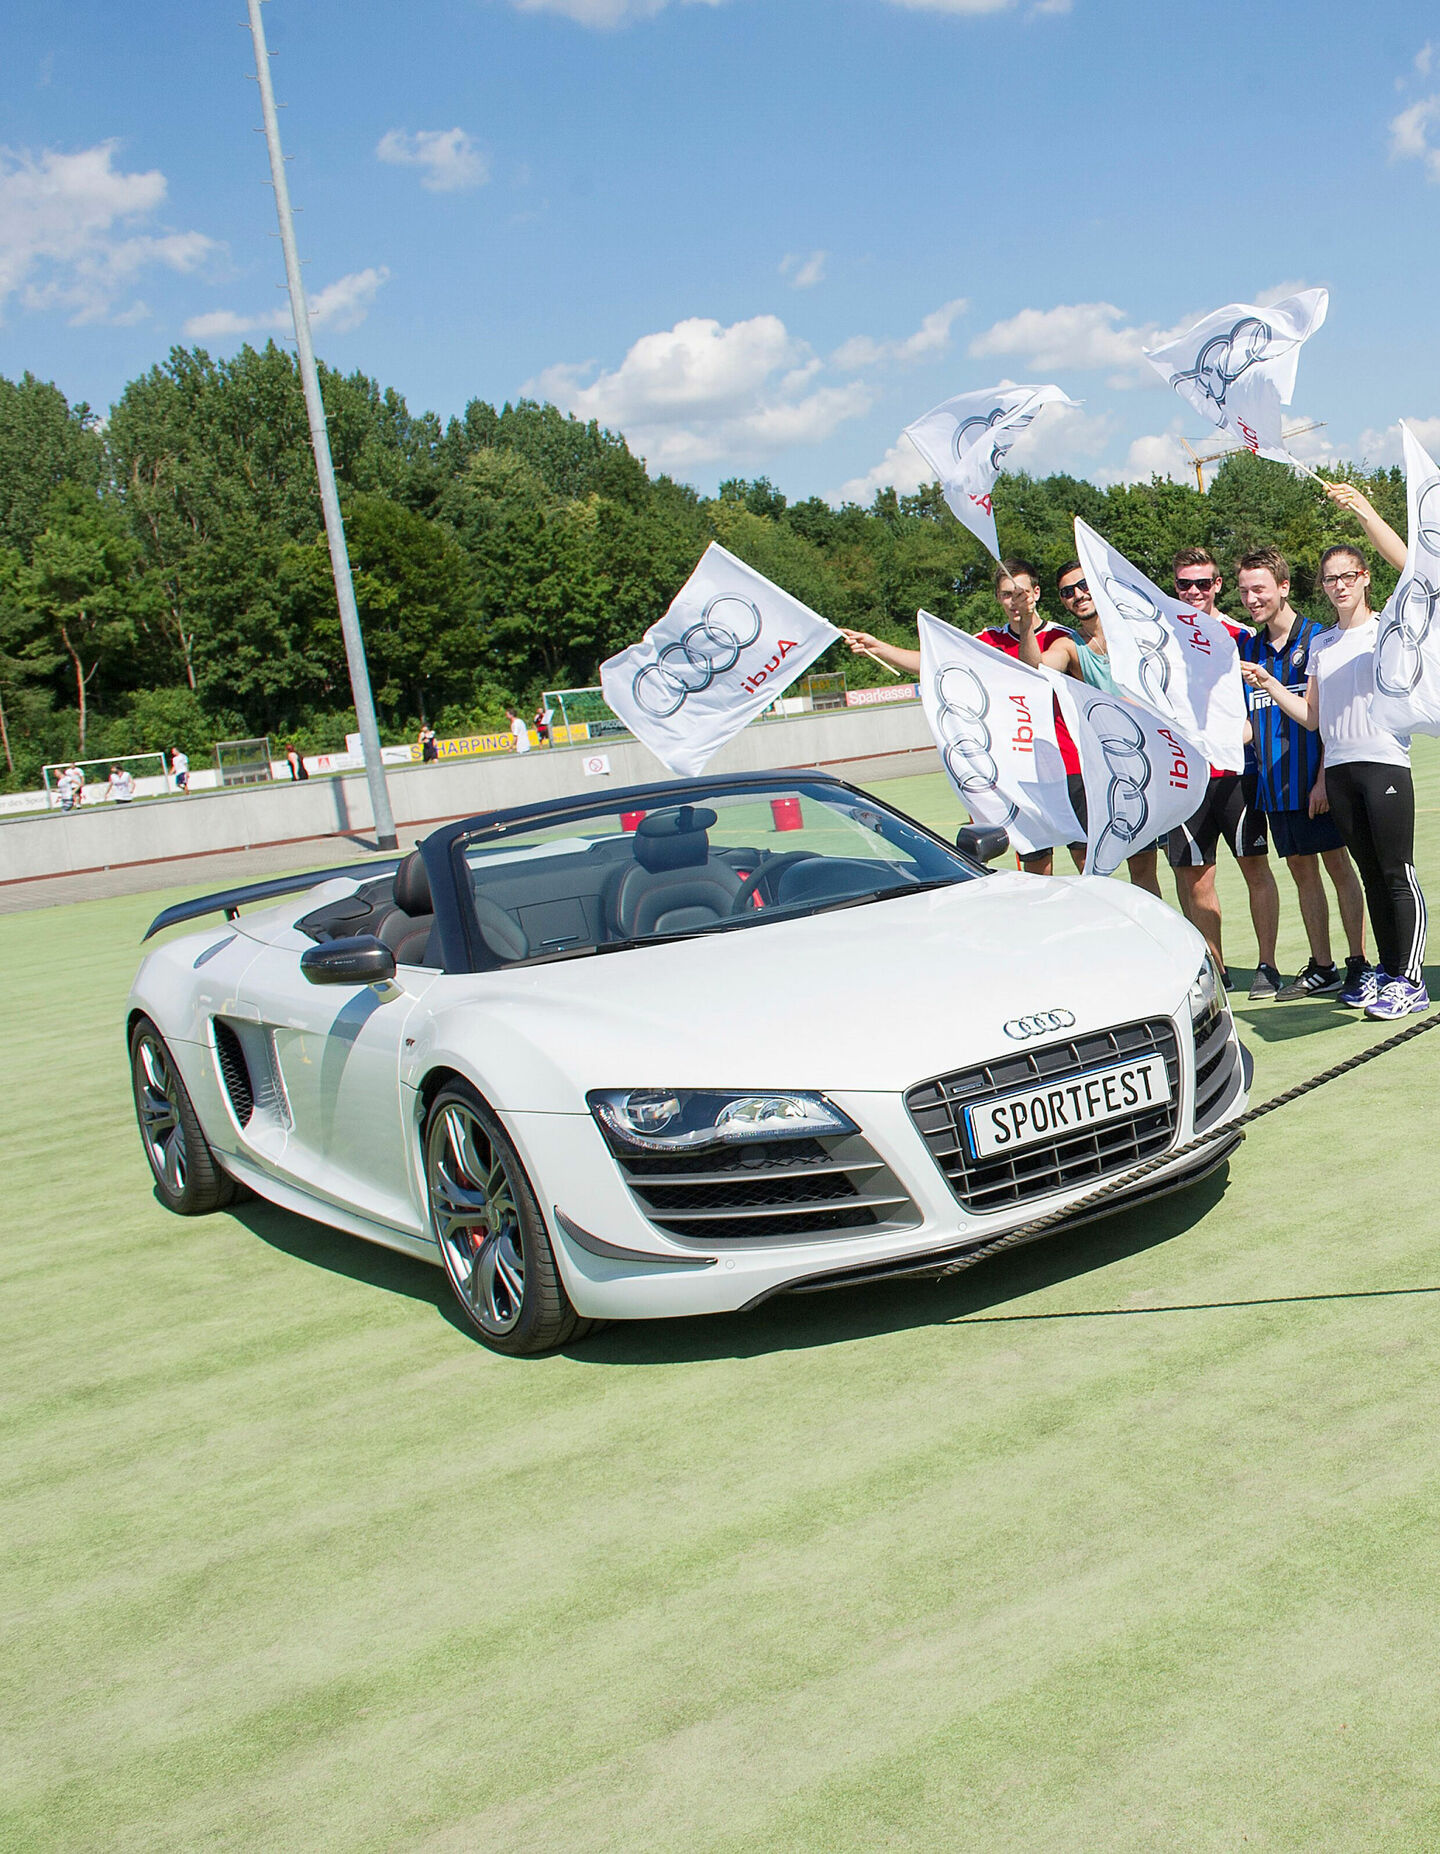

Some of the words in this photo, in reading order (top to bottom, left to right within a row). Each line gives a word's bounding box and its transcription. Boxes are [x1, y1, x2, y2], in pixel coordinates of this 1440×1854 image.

[848, 686, 913, 706] Sparkasse
[410, 734, 512, 760] SHARPING
[991, 1065, 1152, 1145] SPORTFEST
